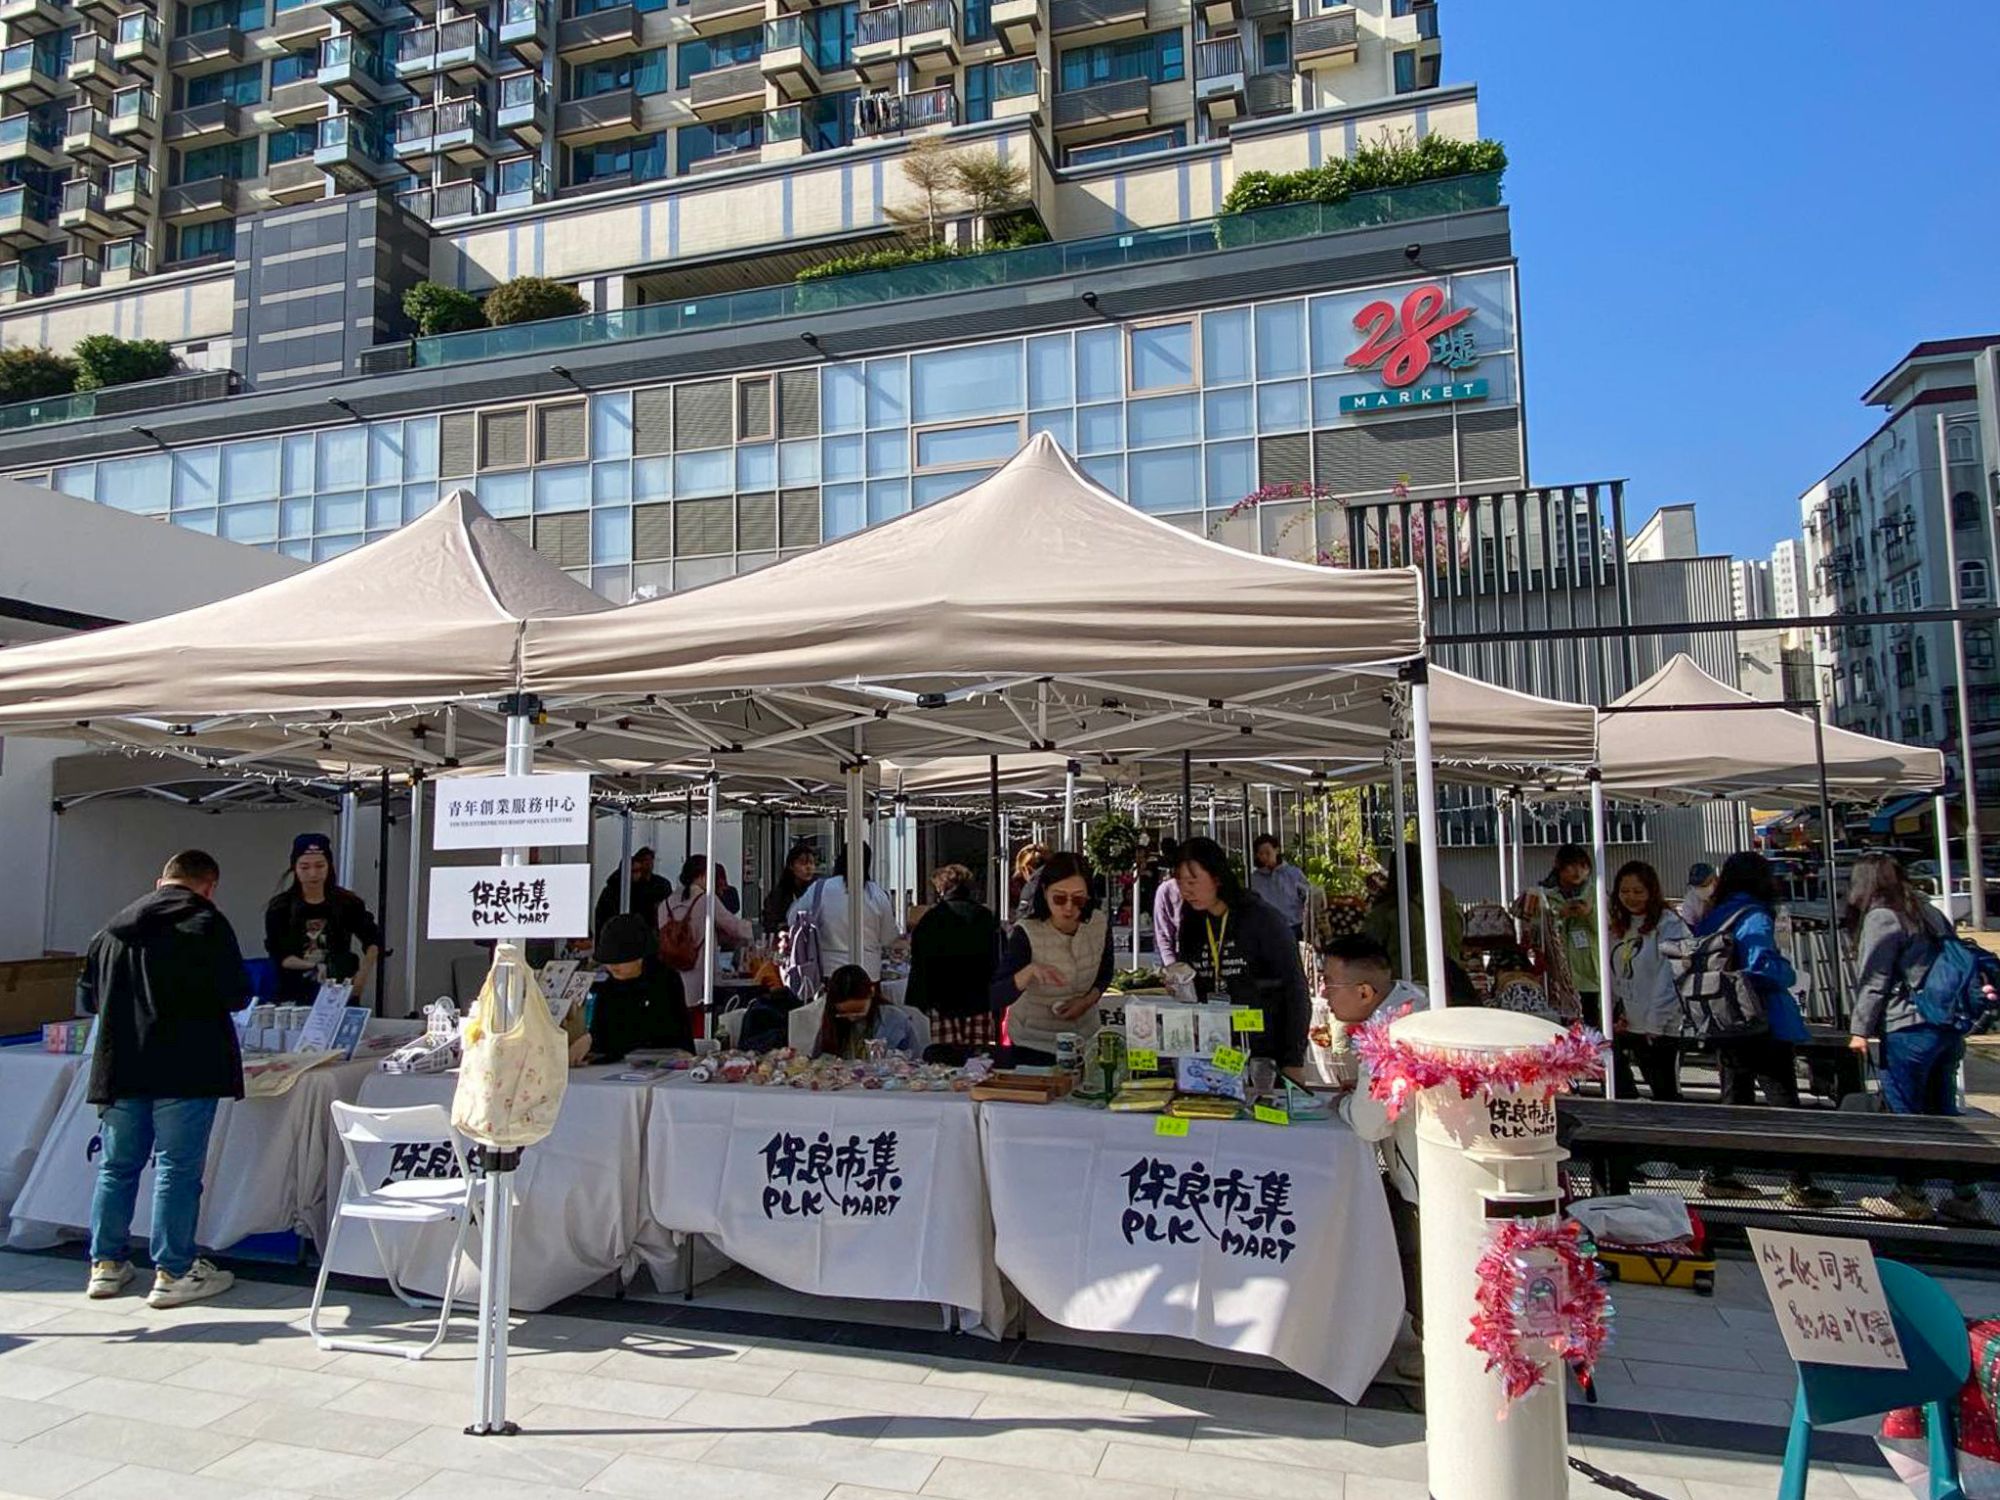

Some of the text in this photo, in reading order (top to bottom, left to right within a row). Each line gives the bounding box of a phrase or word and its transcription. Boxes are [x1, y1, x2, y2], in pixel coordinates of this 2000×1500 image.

[1354, 384, 1473, 407] MARKET
[448, 796, 576, 817] 青年創業服務中心
[468, 878, 550, 911] 保良市集
[472, 911, 550, 927] PLK MART
[1489, 1123, 1556, 1140] PLK MART
[758, 1130, 903, 1193] 保良市集
[762, 1186, 902, 1219] PLK MART
[1120, 1156, 1297, 1235] 保良市集
[1121, 1208, 1297, 1264] PLK MART
[1762, 1243, 1869, 1294] 坐低同我
